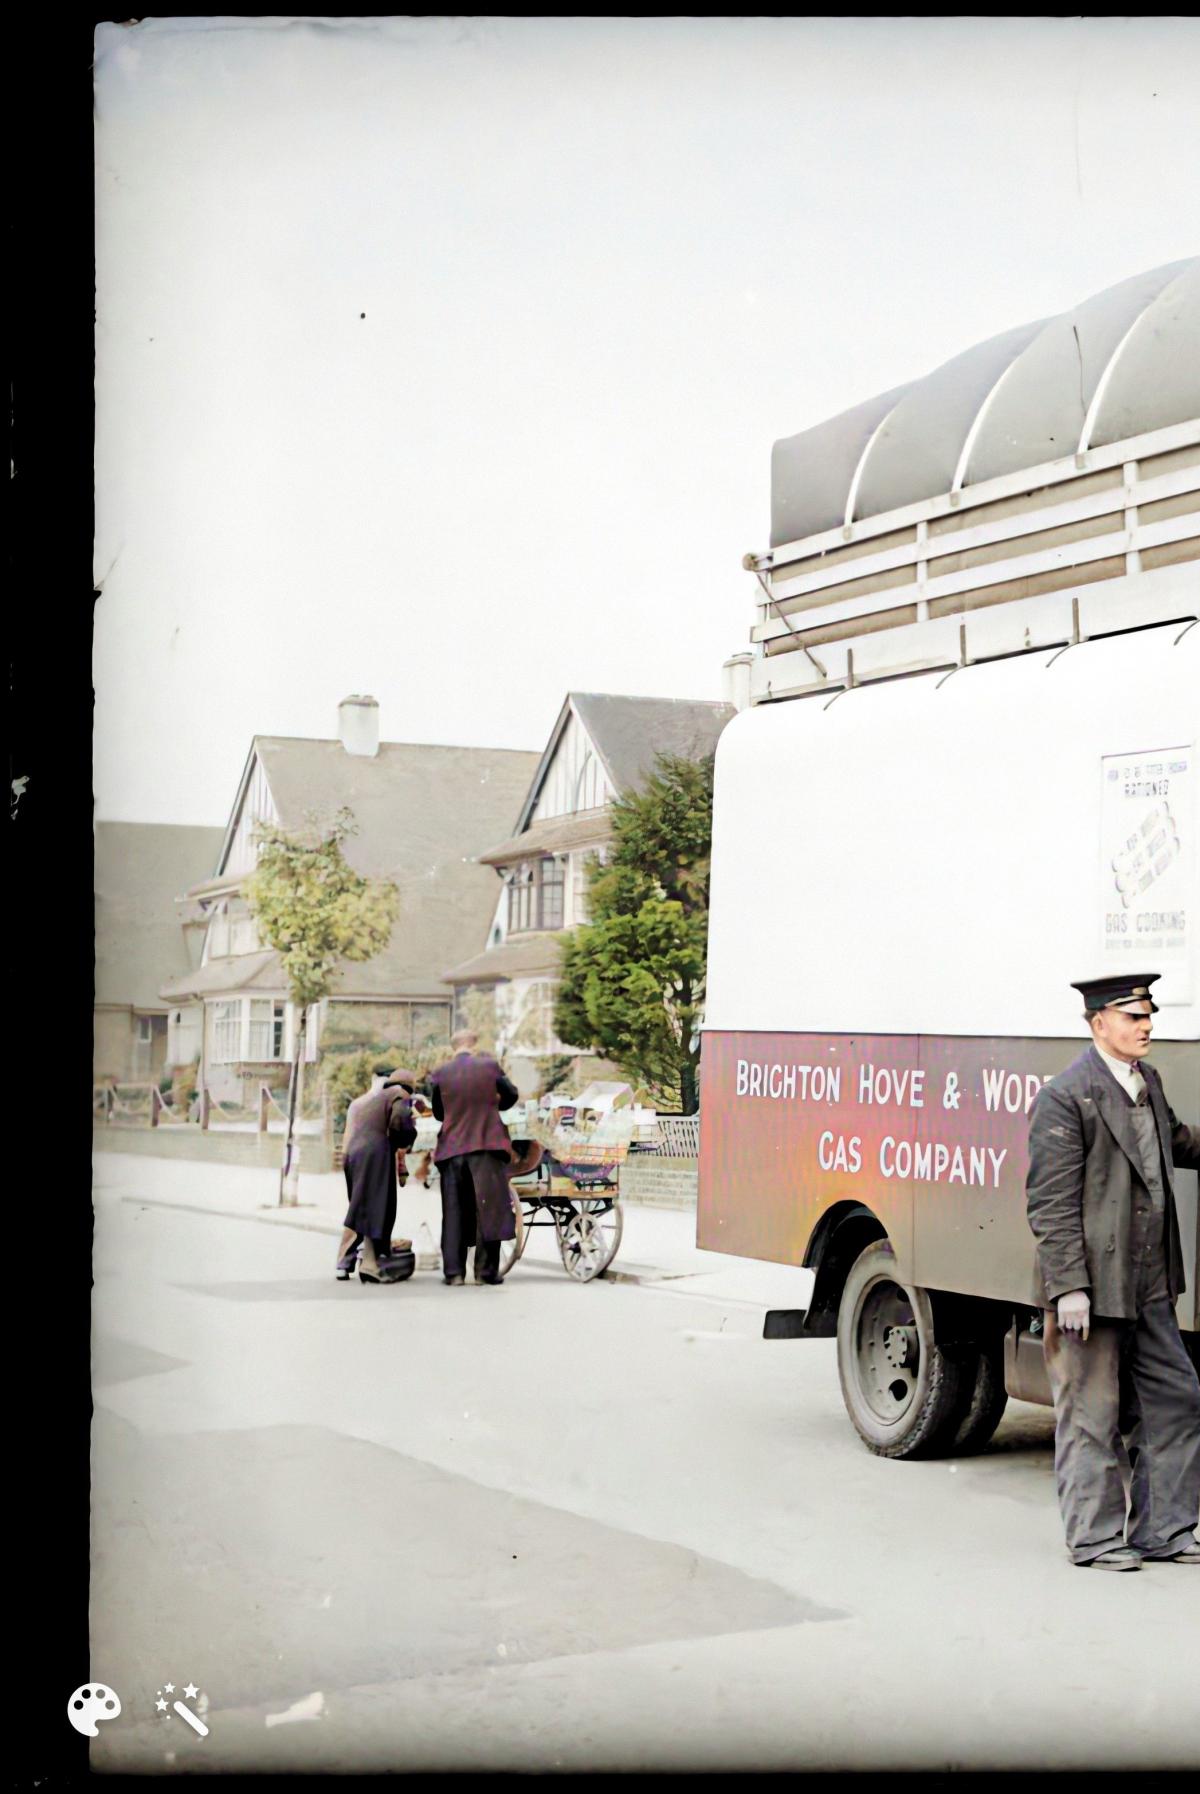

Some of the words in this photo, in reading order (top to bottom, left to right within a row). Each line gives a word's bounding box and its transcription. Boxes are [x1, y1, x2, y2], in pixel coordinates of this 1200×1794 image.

[1105, 912, 1128, 933] GAS
[736, 1059, 841, 1103] BRIGHTON
[858, 1063, 925, 1108] HOVE
[943, 1071, 961, 1109] &
[818, 1131, 862, 1173] GAS
[879, 1135, 1008, 1188] COMPANY
